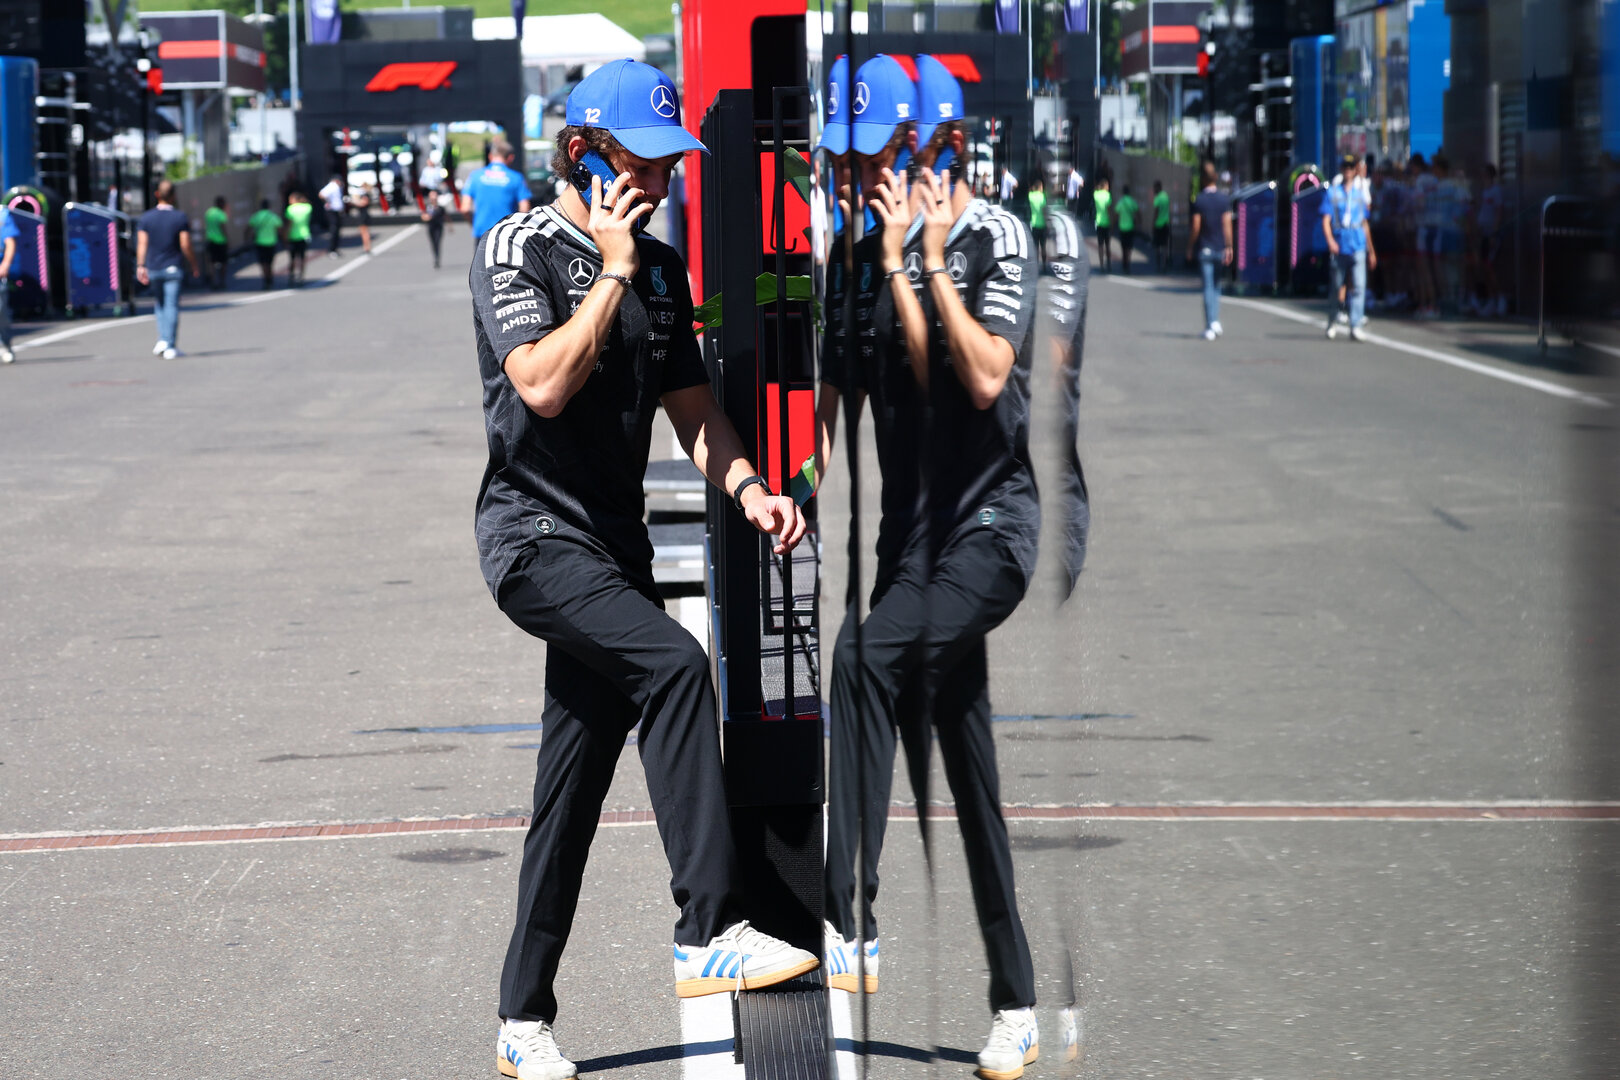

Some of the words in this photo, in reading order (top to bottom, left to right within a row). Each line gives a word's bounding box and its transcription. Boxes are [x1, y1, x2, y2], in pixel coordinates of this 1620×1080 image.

[585, 107, 601, 123] 12
[493, 272, 515, 288] SAP
[502, 315, 532, 333] AMD
